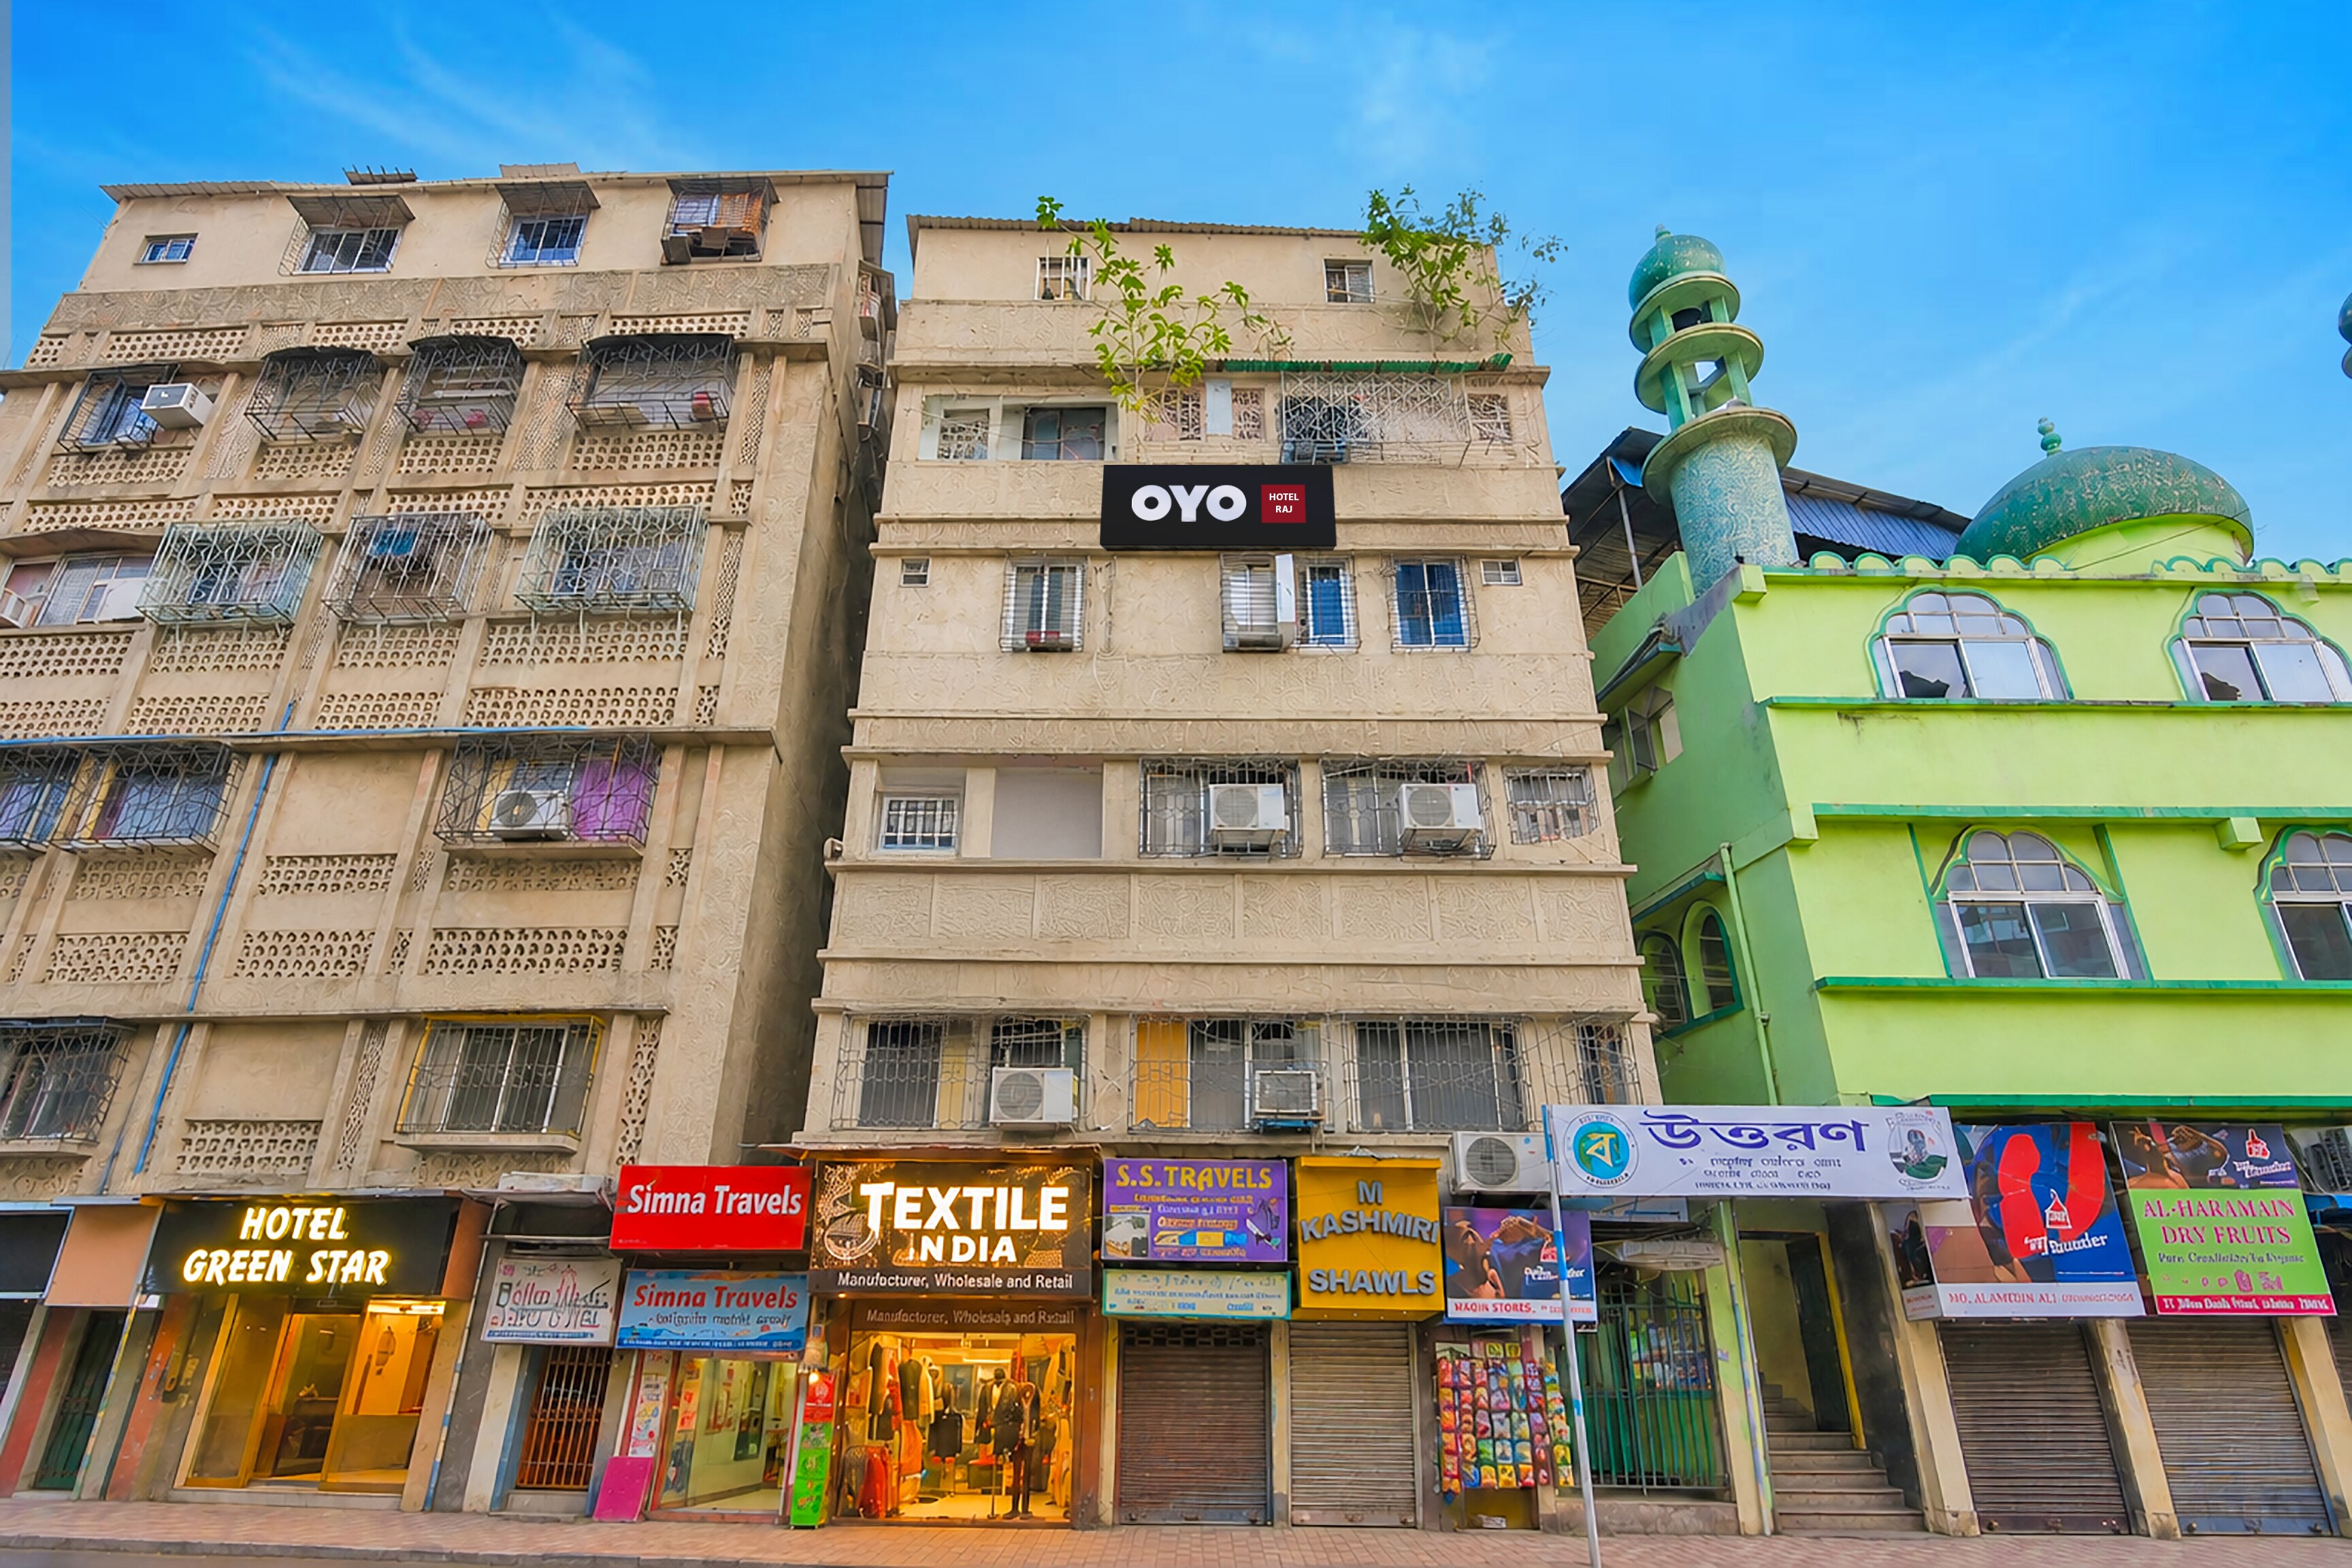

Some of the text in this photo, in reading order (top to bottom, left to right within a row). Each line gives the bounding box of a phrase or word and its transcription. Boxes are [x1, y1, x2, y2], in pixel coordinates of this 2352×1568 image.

[1132, 485, 1247, 522] OYO
[1269, 493, 1299, 501] HOTEL
[1275, 505, 1292, 513] RAJ
[1639, 1110, 1869, 1152] উত্তরণ
[1164, 1166, 1272, 1191] TRAVELS
[627, 1184, 802, 1215] Simna Travels
[1358, 1181, 1382, 1204] M
[860, 1182, 1069, 1238] TEXTILE
[2144, 1199, 2295, 1218] AL-HARAMAIN
[240, 1207, 348, 1240] HOTEL
[1301, 1210, 1439, 1244] KASHMIRI
[2161, 1226, 2291, 1244] DRY FRUITS
[183, 1250, 390, 1286] GREEN STAR
[837, 1271, 1073, 1289] Manufacturer, Wholesale and Retail
[1309, 1269, 1436, 1295] SHAWLS
[634, 1283, 706, 1307] Simna
[714, 1284, 798, 1309] Travels
